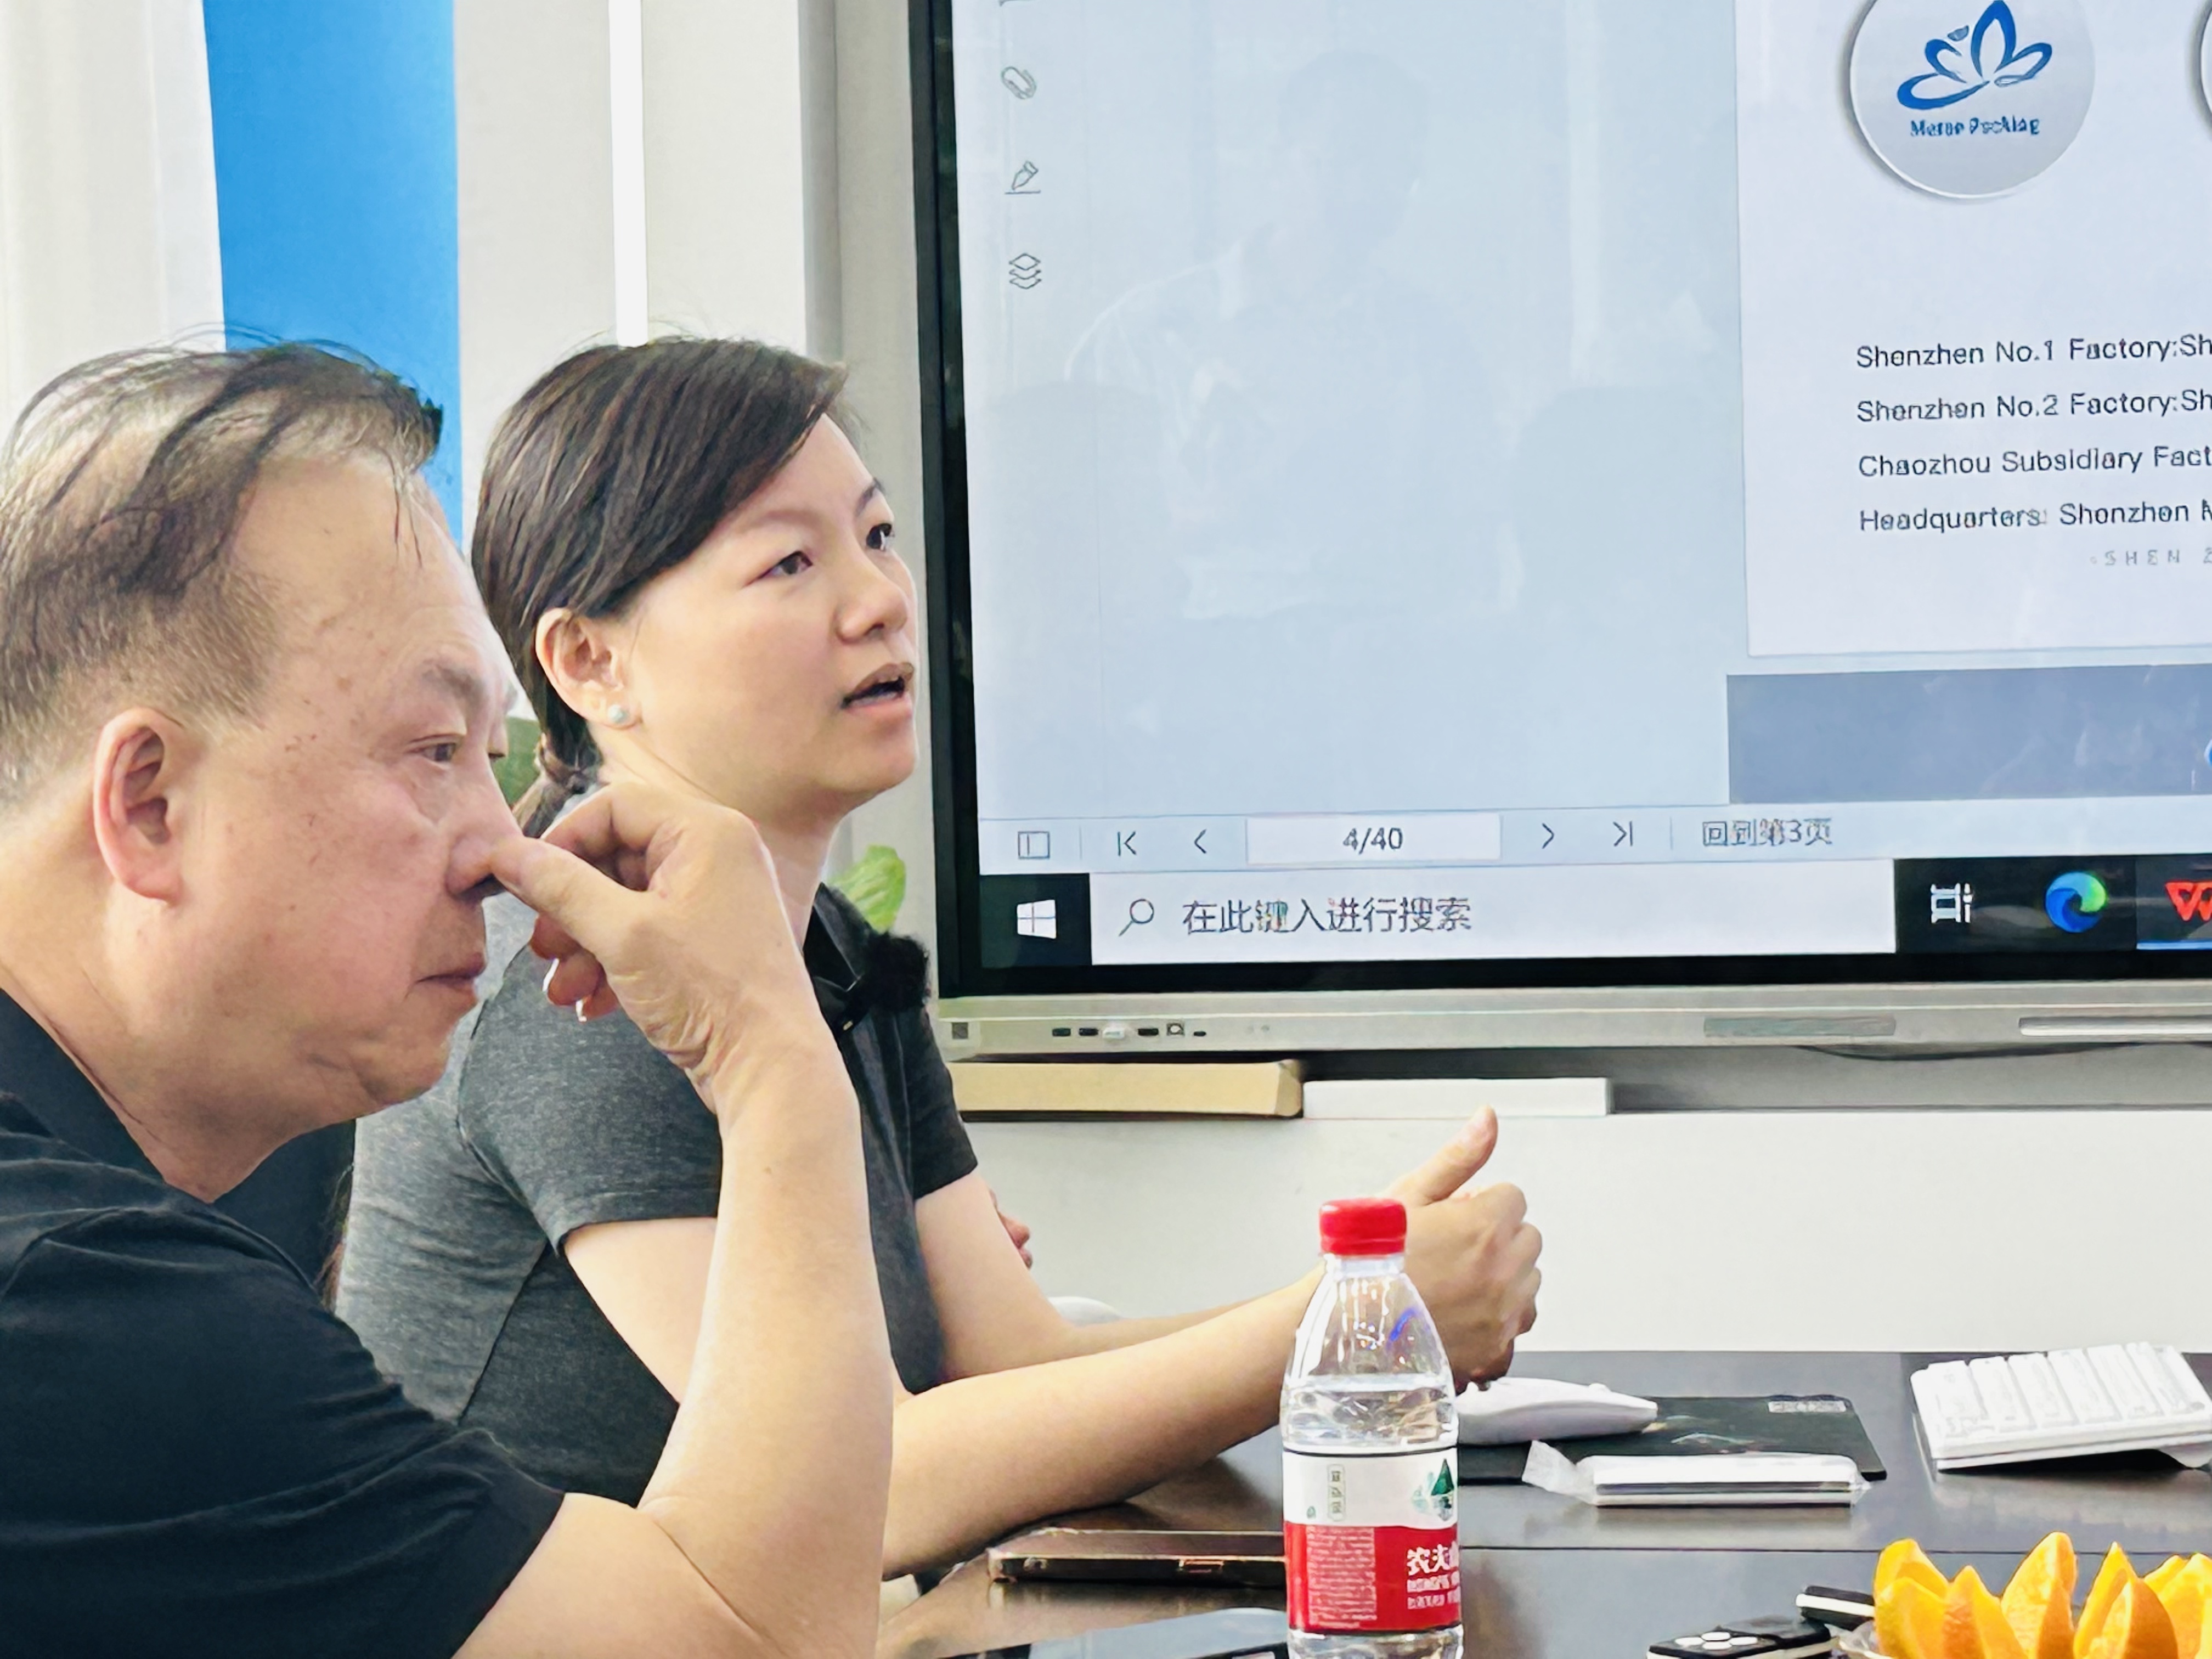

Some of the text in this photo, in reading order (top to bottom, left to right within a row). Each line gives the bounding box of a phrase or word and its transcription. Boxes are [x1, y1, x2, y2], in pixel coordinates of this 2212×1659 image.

[1857, 343, 1984, 368] Shenzhen
[1996, 340, 2052, 362] No.1
[1857, 398, 1985, 422] Shenzhen
[1997, 394, 2058, 417] No.2
[1859, 454, 1990, 477] Chaozhou
[2002, 448, 2143, 473] Subsidiary
[2059, 501, 2189, 525] Shenzhen
[1342, 827, 1403, 855] 4/40
[1702, 818, 1832, 846] 回到第3页
[1183, 896, 1472, 935] 在此键入进行搜索
